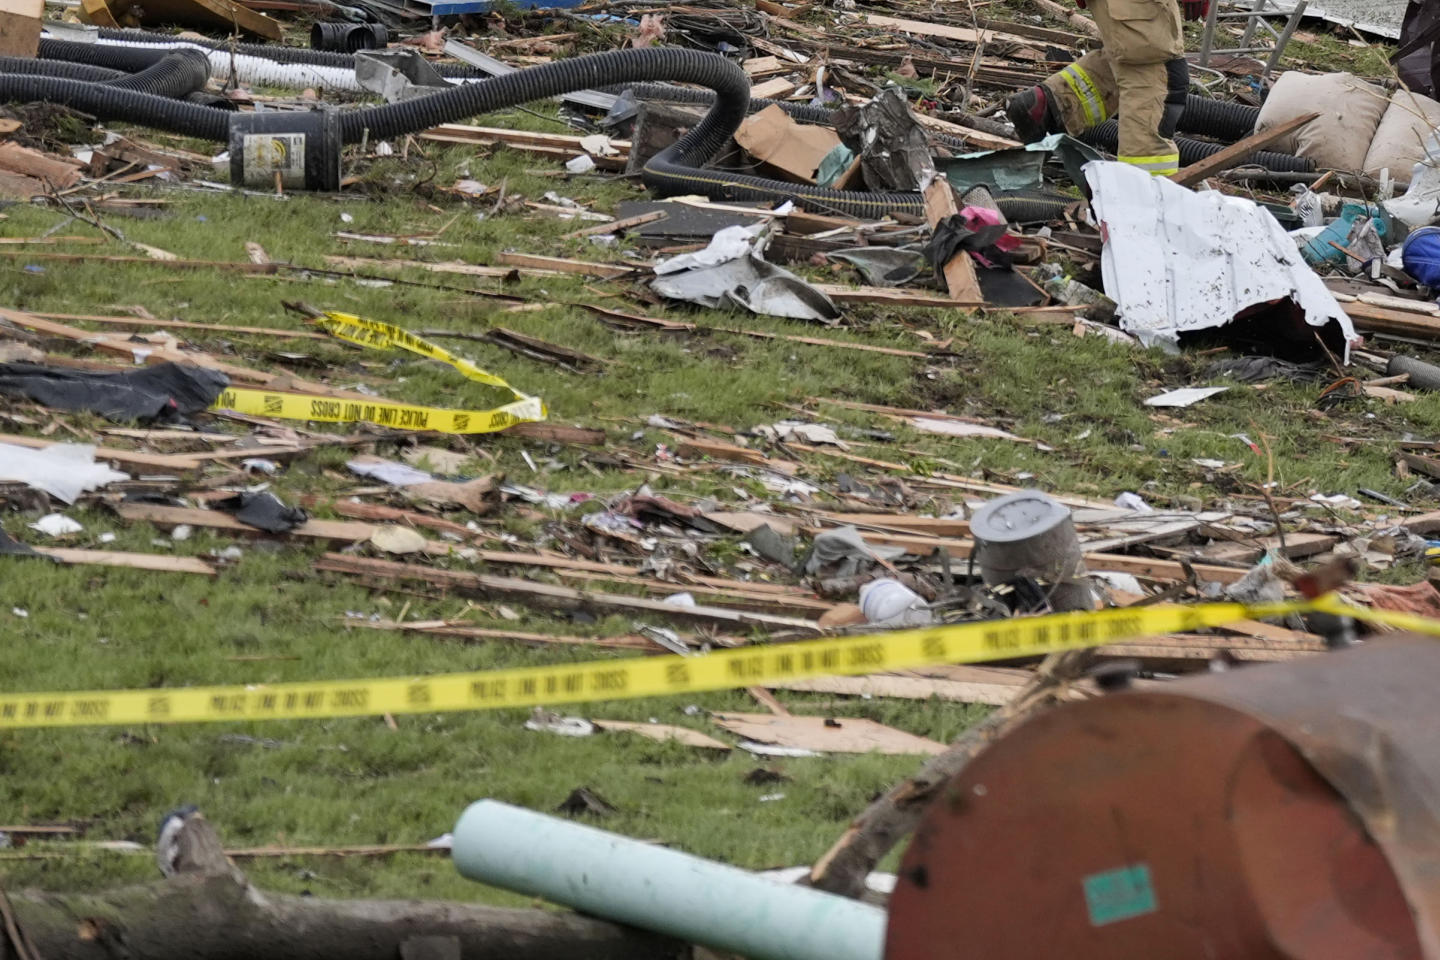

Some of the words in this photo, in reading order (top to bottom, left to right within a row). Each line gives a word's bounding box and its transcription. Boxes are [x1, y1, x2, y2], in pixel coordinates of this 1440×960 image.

[310, 399, 340, 418] CROSS
[344, 402, 361, 421] NOT
[364, 404, 376, 422] DO
[377, 406, 398, 424] LINE
[400, 408, 429, 428] POLICE
